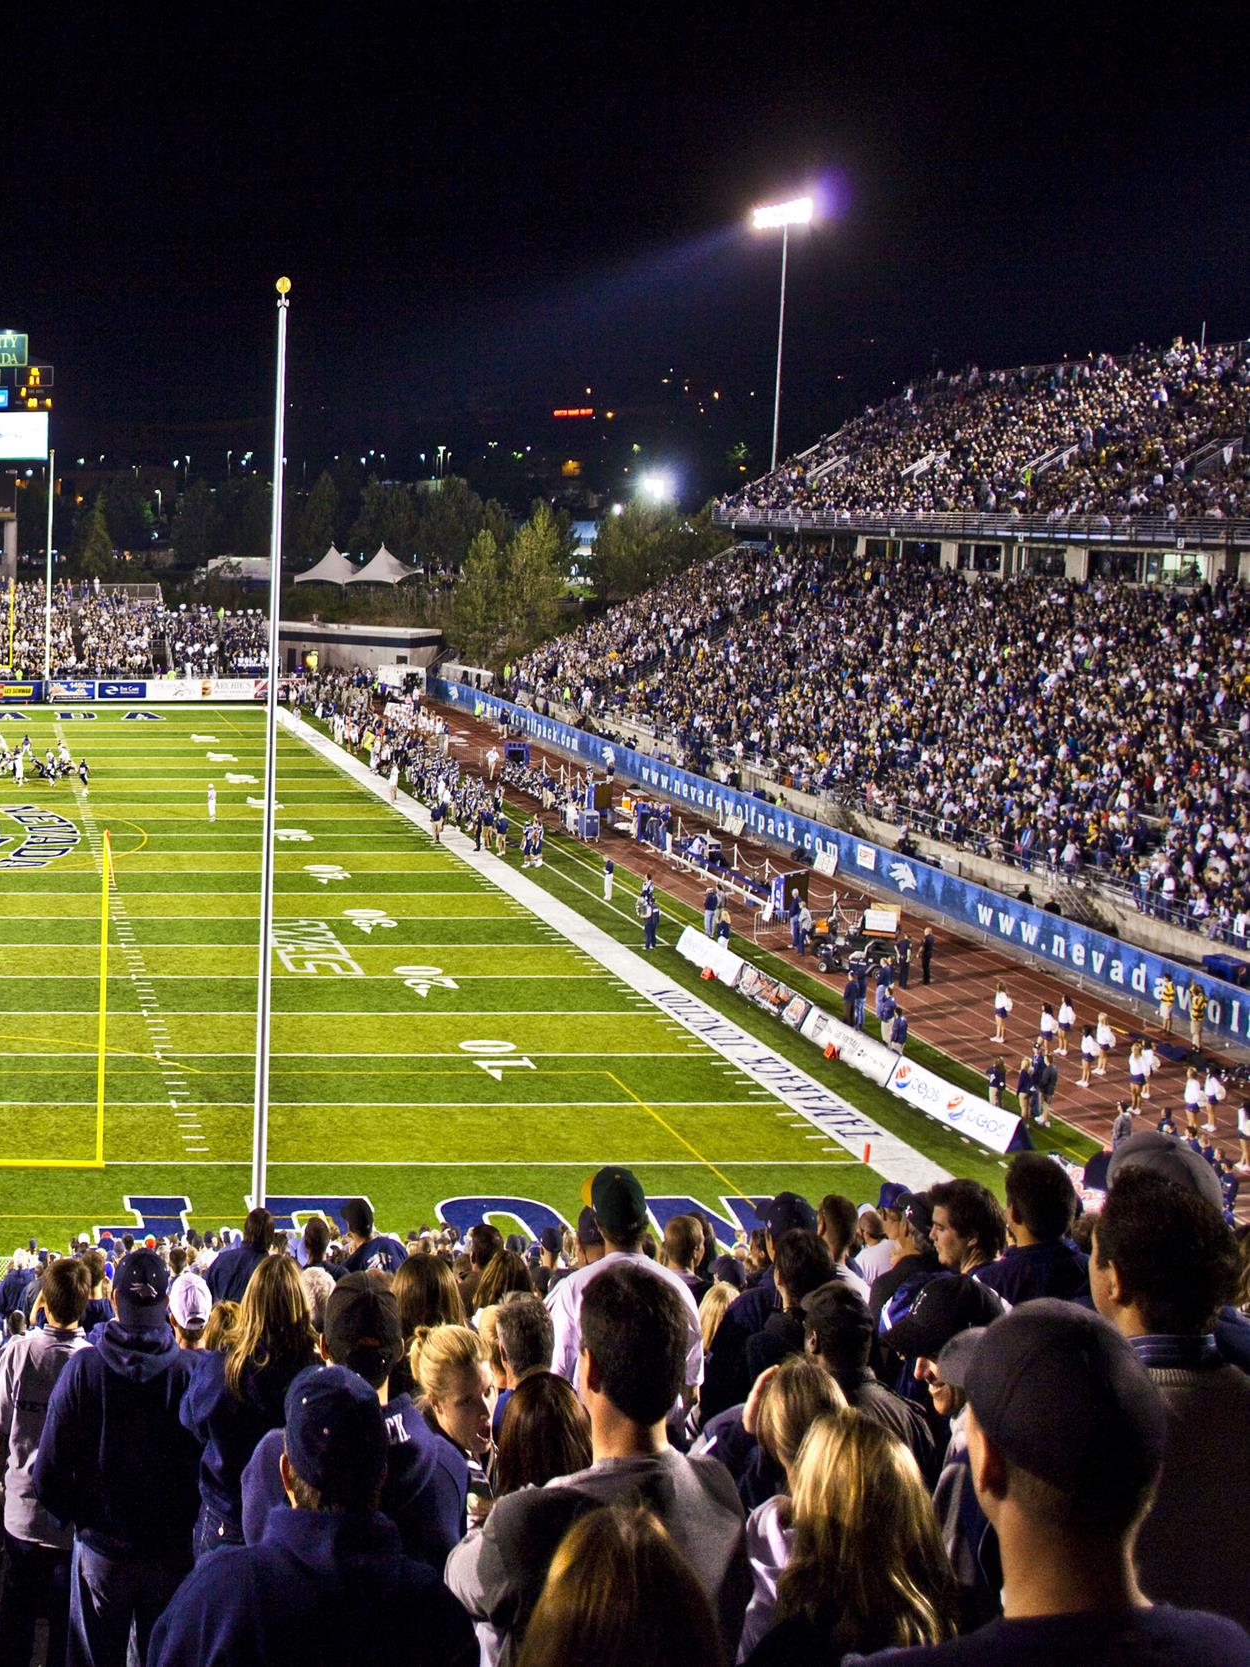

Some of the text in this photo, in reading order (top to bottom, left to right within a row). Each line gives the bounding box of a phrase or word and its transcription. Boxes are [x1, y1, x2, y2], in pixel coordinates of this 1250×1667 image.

[342, 908, 399, 929] 30
[393, 965, 460, 990] 20
[646, 989, 759, 1049] JUNCTION
[458, 1039, 538, 1070] 10
